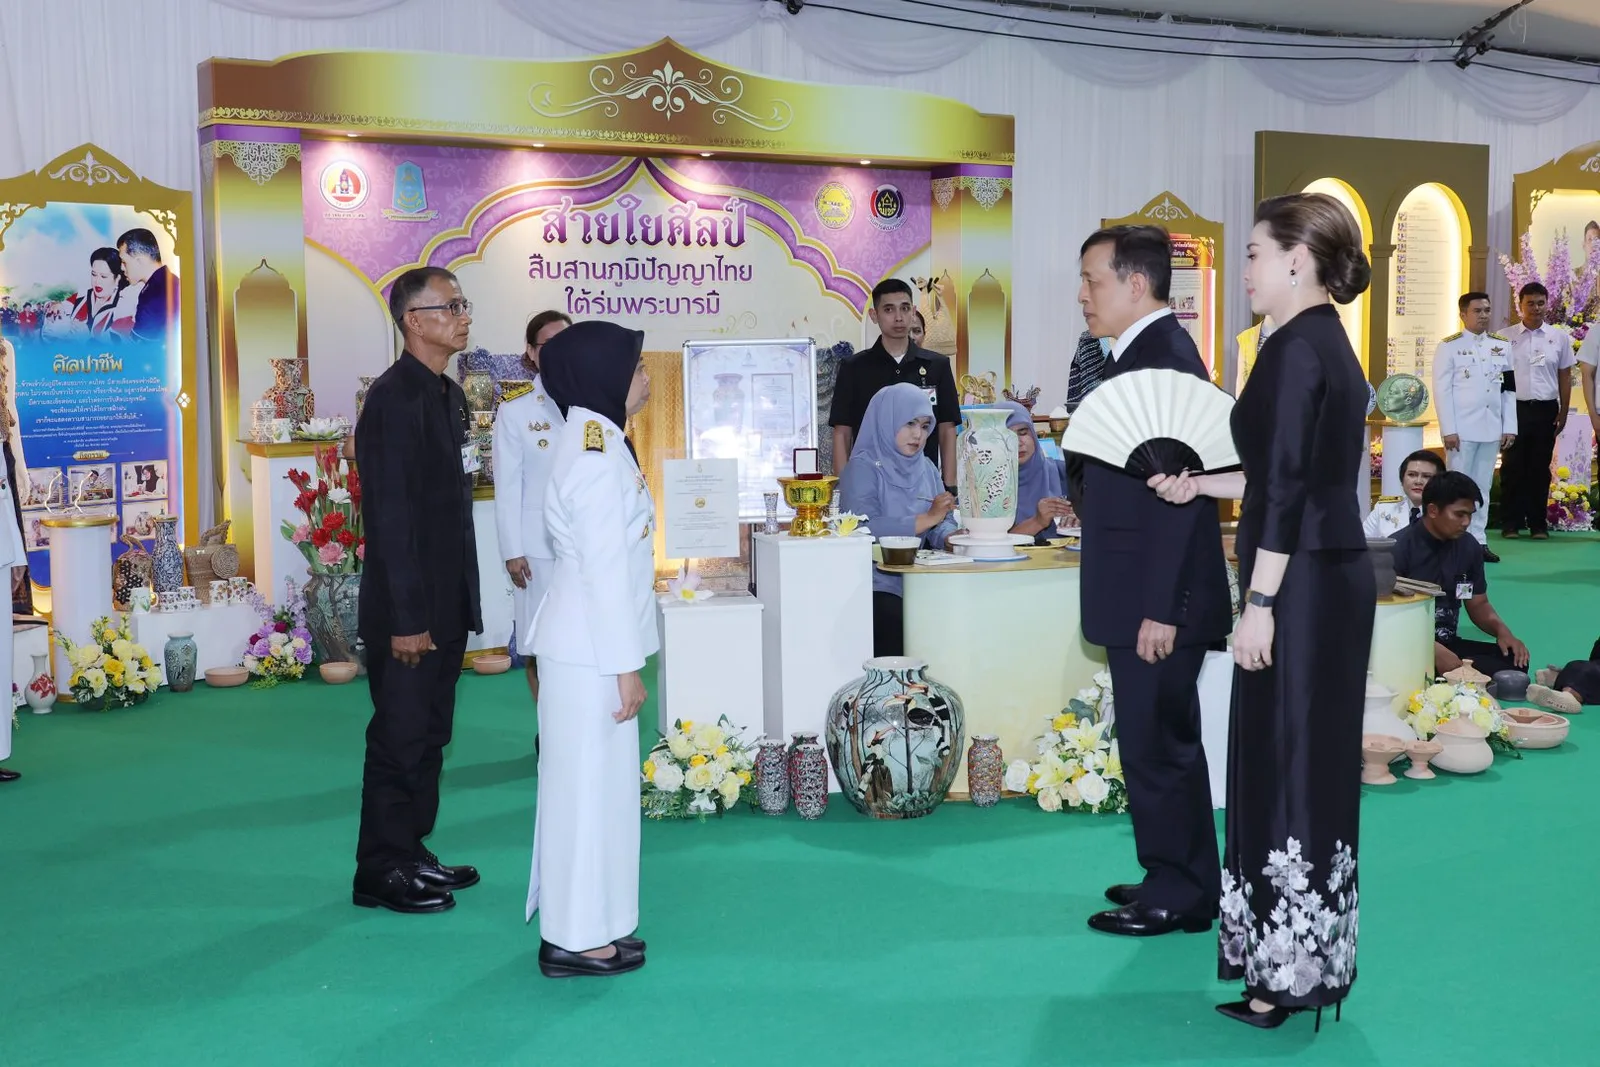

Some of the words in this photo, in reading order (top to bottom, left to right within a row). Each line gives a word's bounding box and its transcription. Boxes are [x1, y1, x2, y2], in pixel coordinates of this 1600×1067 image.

[542, 193, 750, 248] สายใยศิลป์
[529, 254, 753, 287] สืบสานภูมิปัญญาไทย
[53, 352, 123, 374] ศิลปาชีพ
